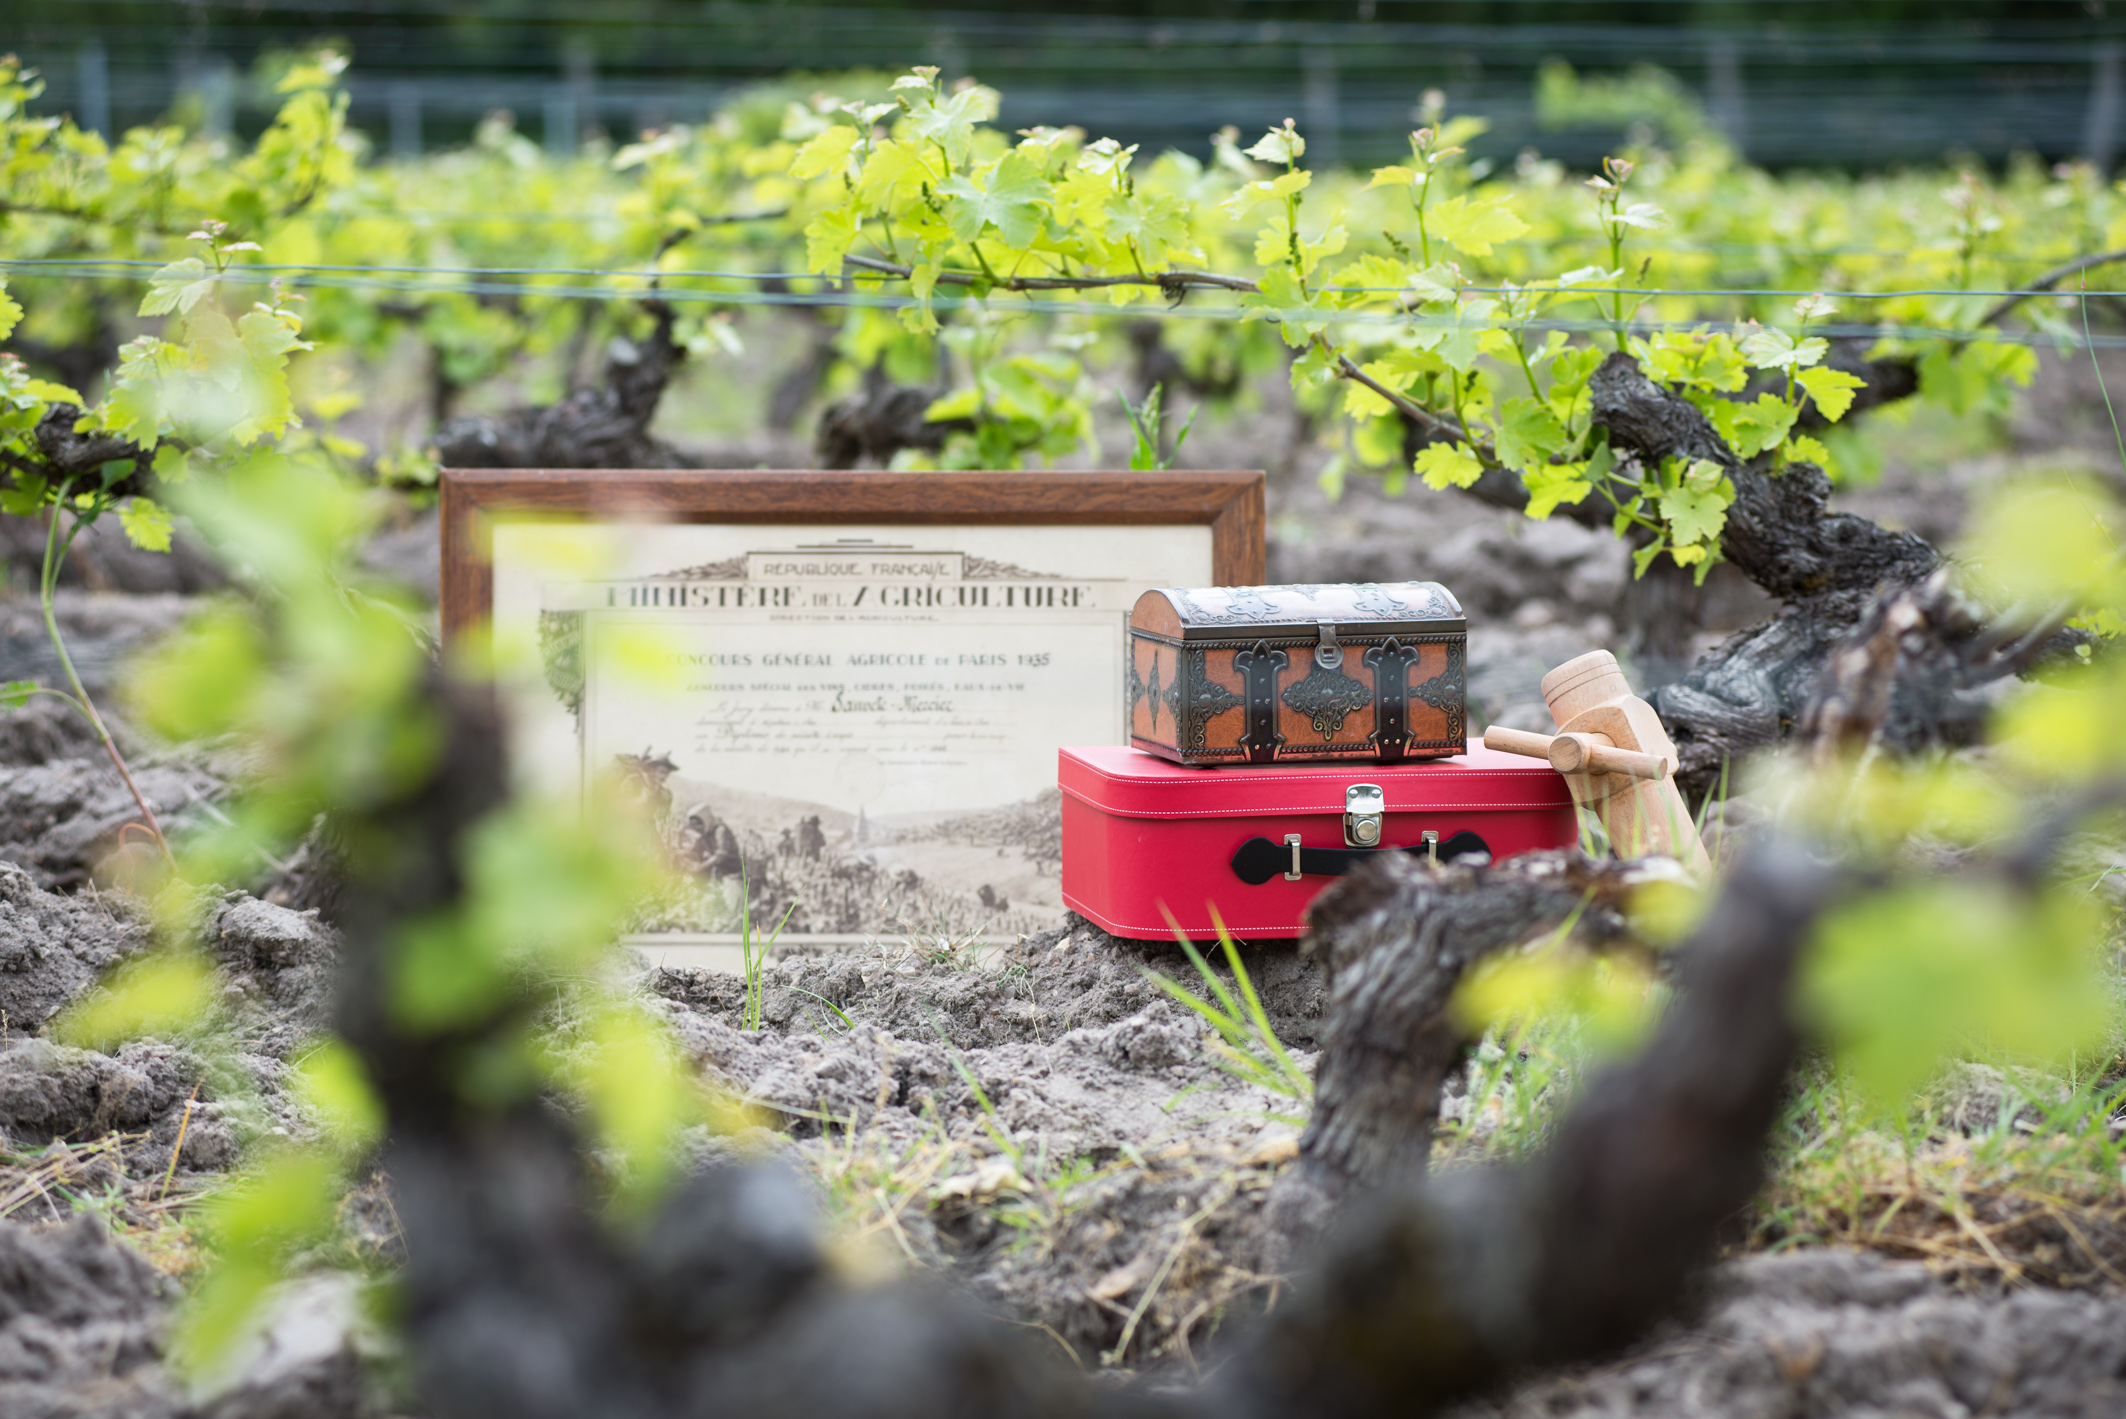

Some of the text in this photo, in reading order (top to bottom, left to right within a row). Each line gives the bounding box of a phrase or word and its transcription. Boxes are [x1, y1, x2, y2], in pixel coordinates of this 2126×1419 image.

[763, 561, 862, 576] RÉPUBLIQUE
[606, 583, 806, 608] MINISTÈRE
[812, 593, 829, 608] DE
[665, 651, 1051, 667] CONCOURS GÉNÉRAL AGRICOLE DE PARIS 1935
